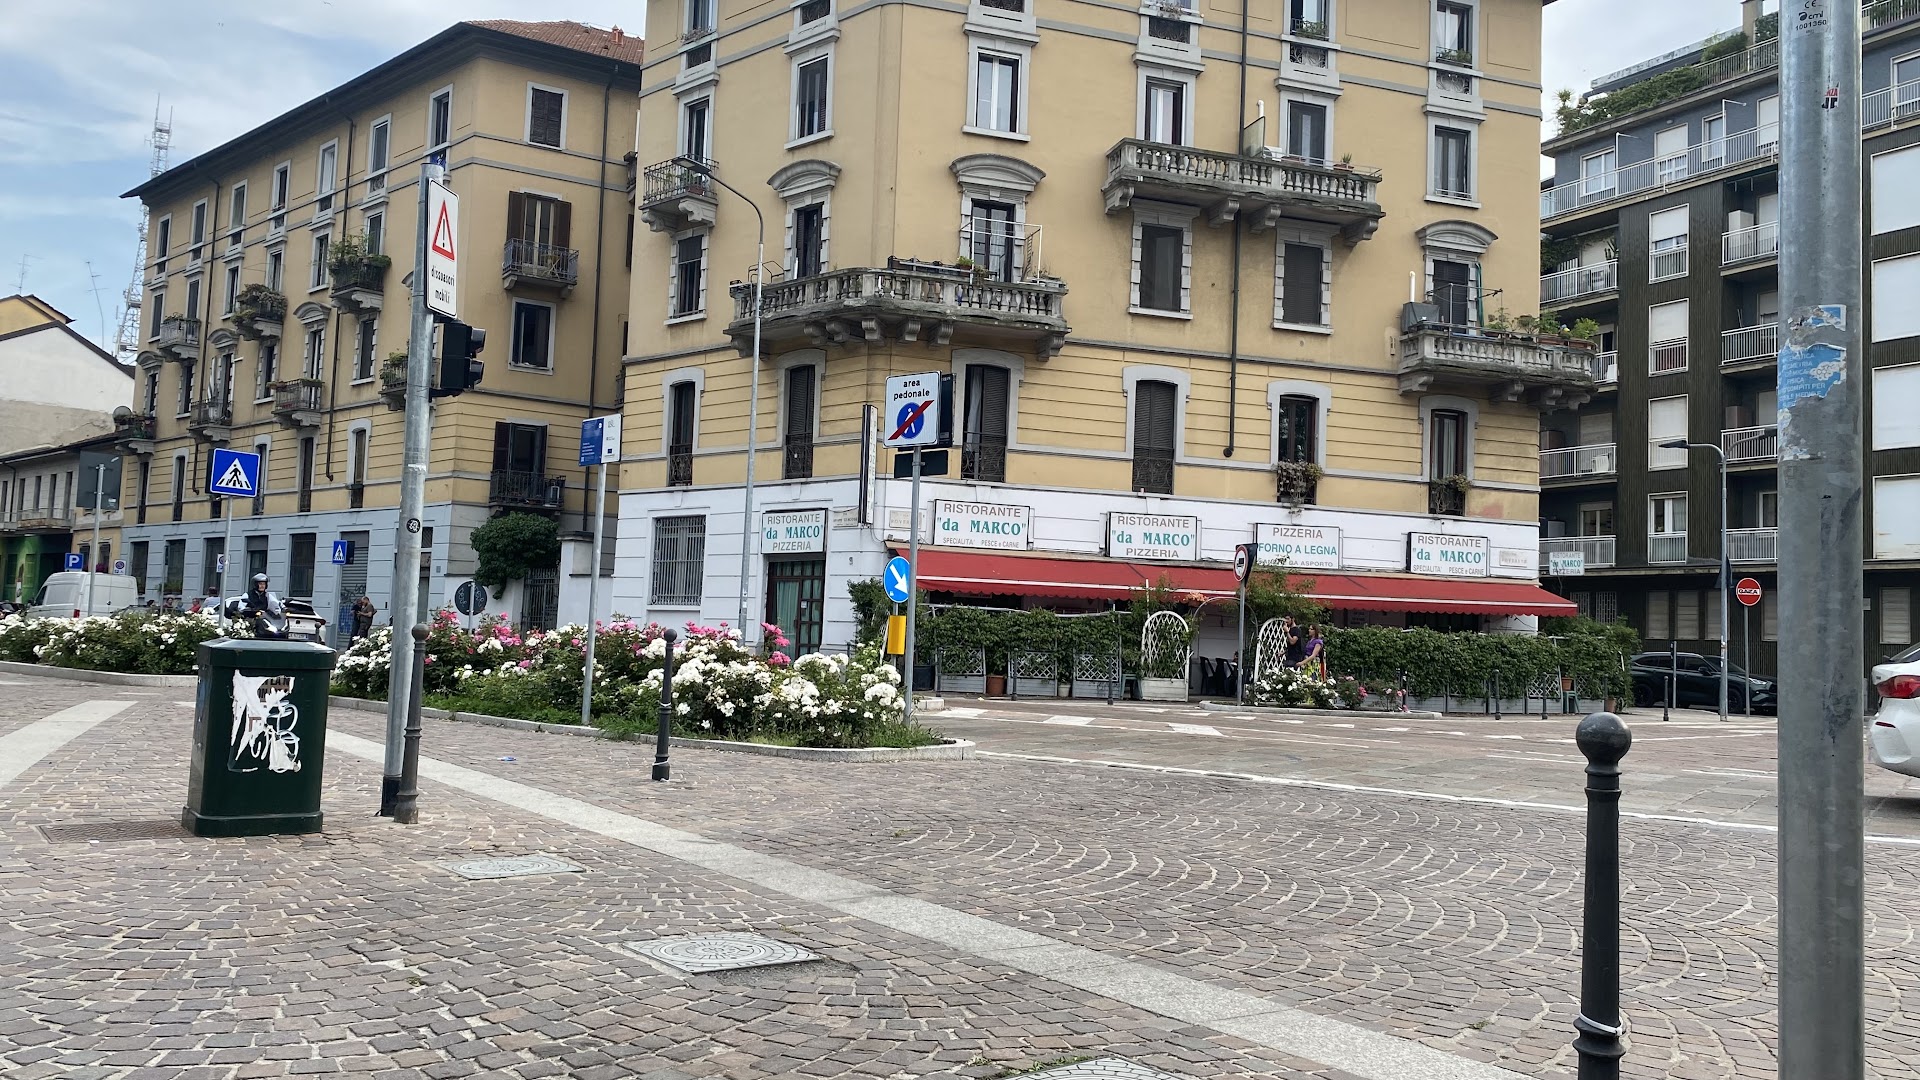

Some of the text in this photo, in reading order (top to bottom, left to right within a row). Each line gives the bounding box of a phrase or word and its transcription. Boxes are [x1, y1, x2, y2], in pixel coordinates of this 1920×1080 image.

[431, 265, 455, 287] dissuasori
[434, 289, 450, 303] mobili
[903, 379, 920, 387] area
[893, 389, 930, 401] pedonale
[944, 503, 1021, 517] RISTORANTE
[767, 514, 820, 524] RISTORANTE
[1117, 516, 1189, 528] RISTORANTE
[763, 525, 823, 539] "da MARCO"
[937, 517, 1026, 535] "da MARCO"
[1112, 530, 1194, 546] "da MARCO"
[1272, 527, 1323, 538] PIZZERIA
[772, 541, 811, 551] PIZZERIA
[981, 539, 997, 547] PESCE
[1418, 535, 1481, 547] RISTORANTE
[1126, 548, 1179, 558] PIZZERIA
[1258, 543, 1337, 555] FORNO A LEGNA
[69, 555, 80, 567] P
[1413, 548, 1485, 563] "da MARCO"
